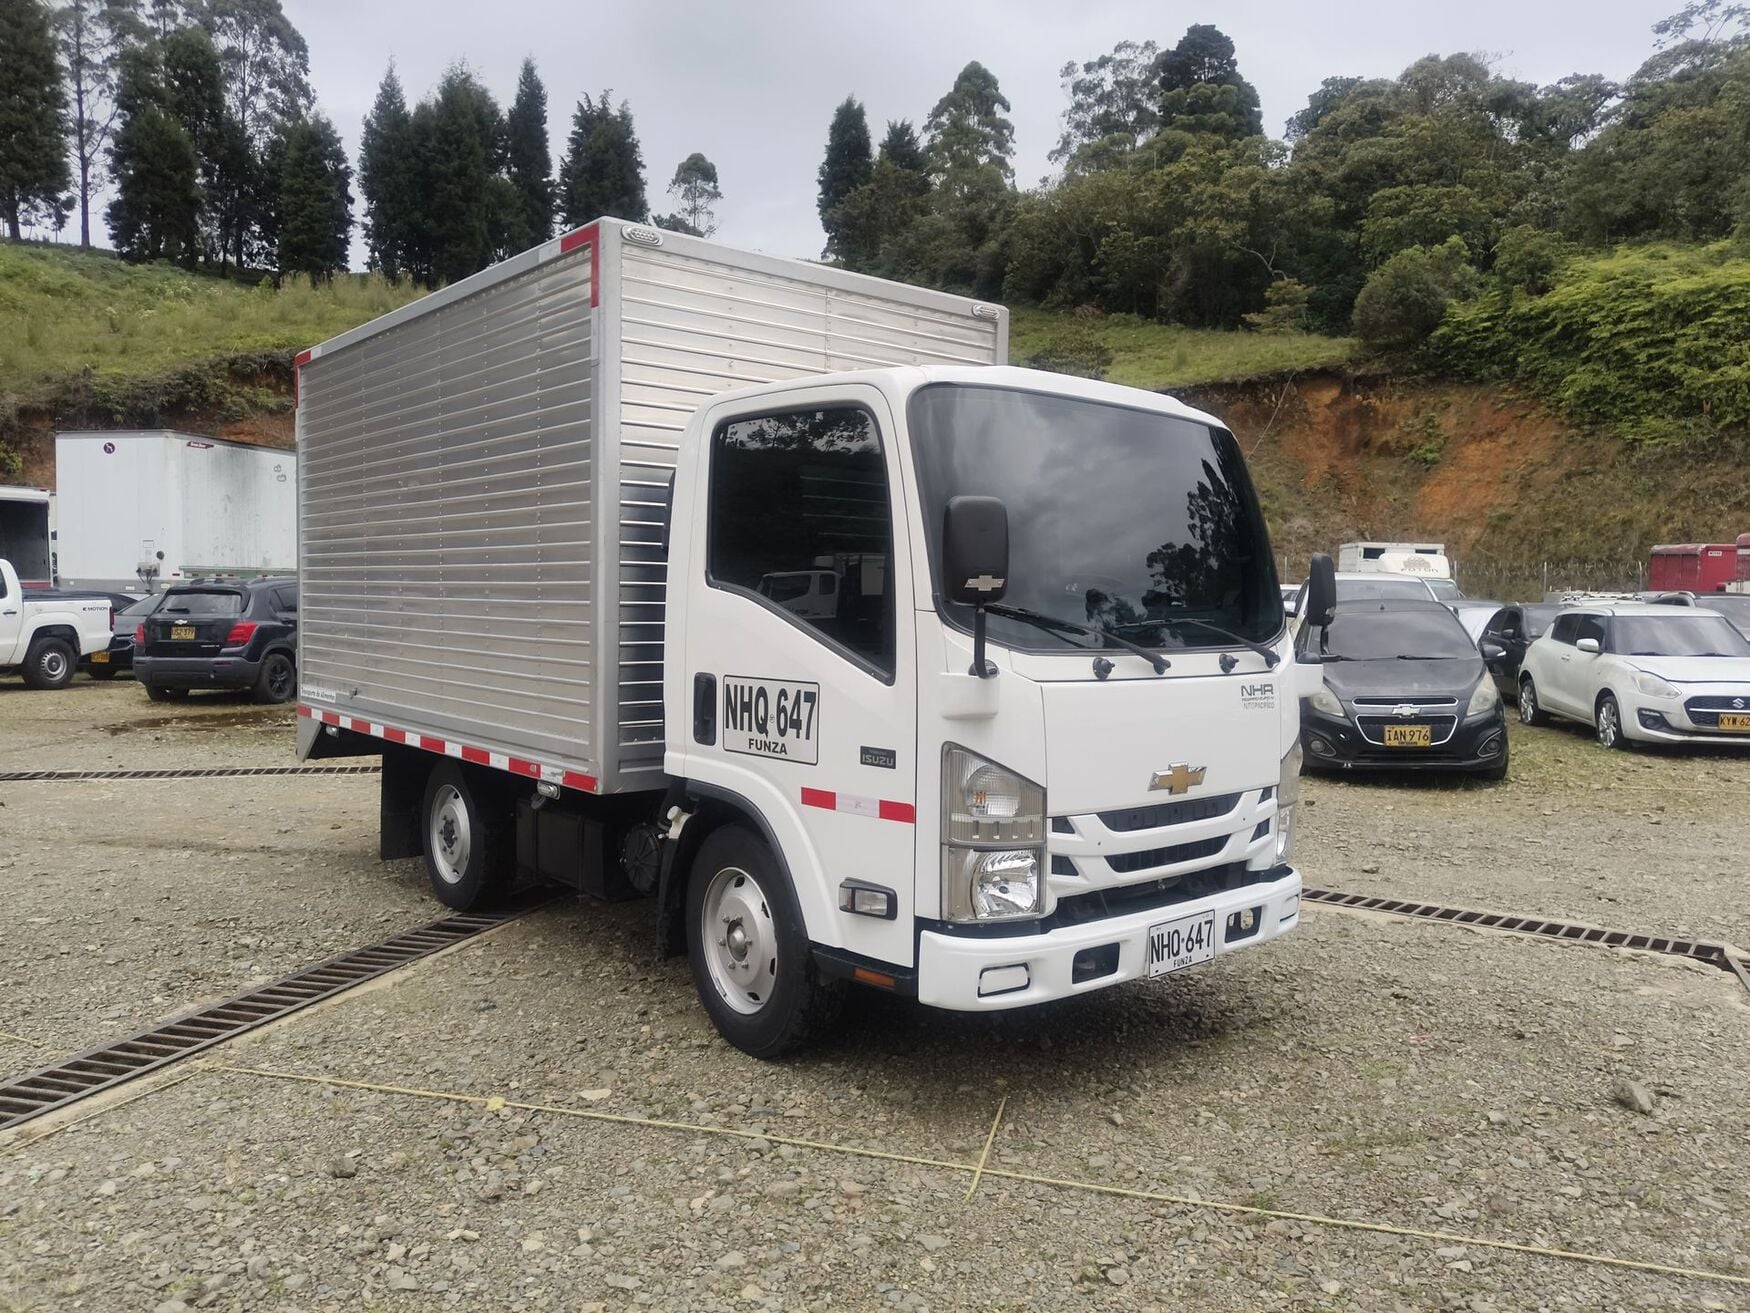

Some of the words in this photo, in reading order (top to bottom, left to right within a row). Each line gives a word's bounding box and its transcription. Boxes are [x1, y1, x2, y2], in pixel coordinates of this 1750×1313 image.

[1241, 683, 1274, 697] NHR
[748, 738, 787, 755] FUNZA
[862, 753, 894, 766] ISUZU
[1173, 956, 1193, 968] FUNZA
